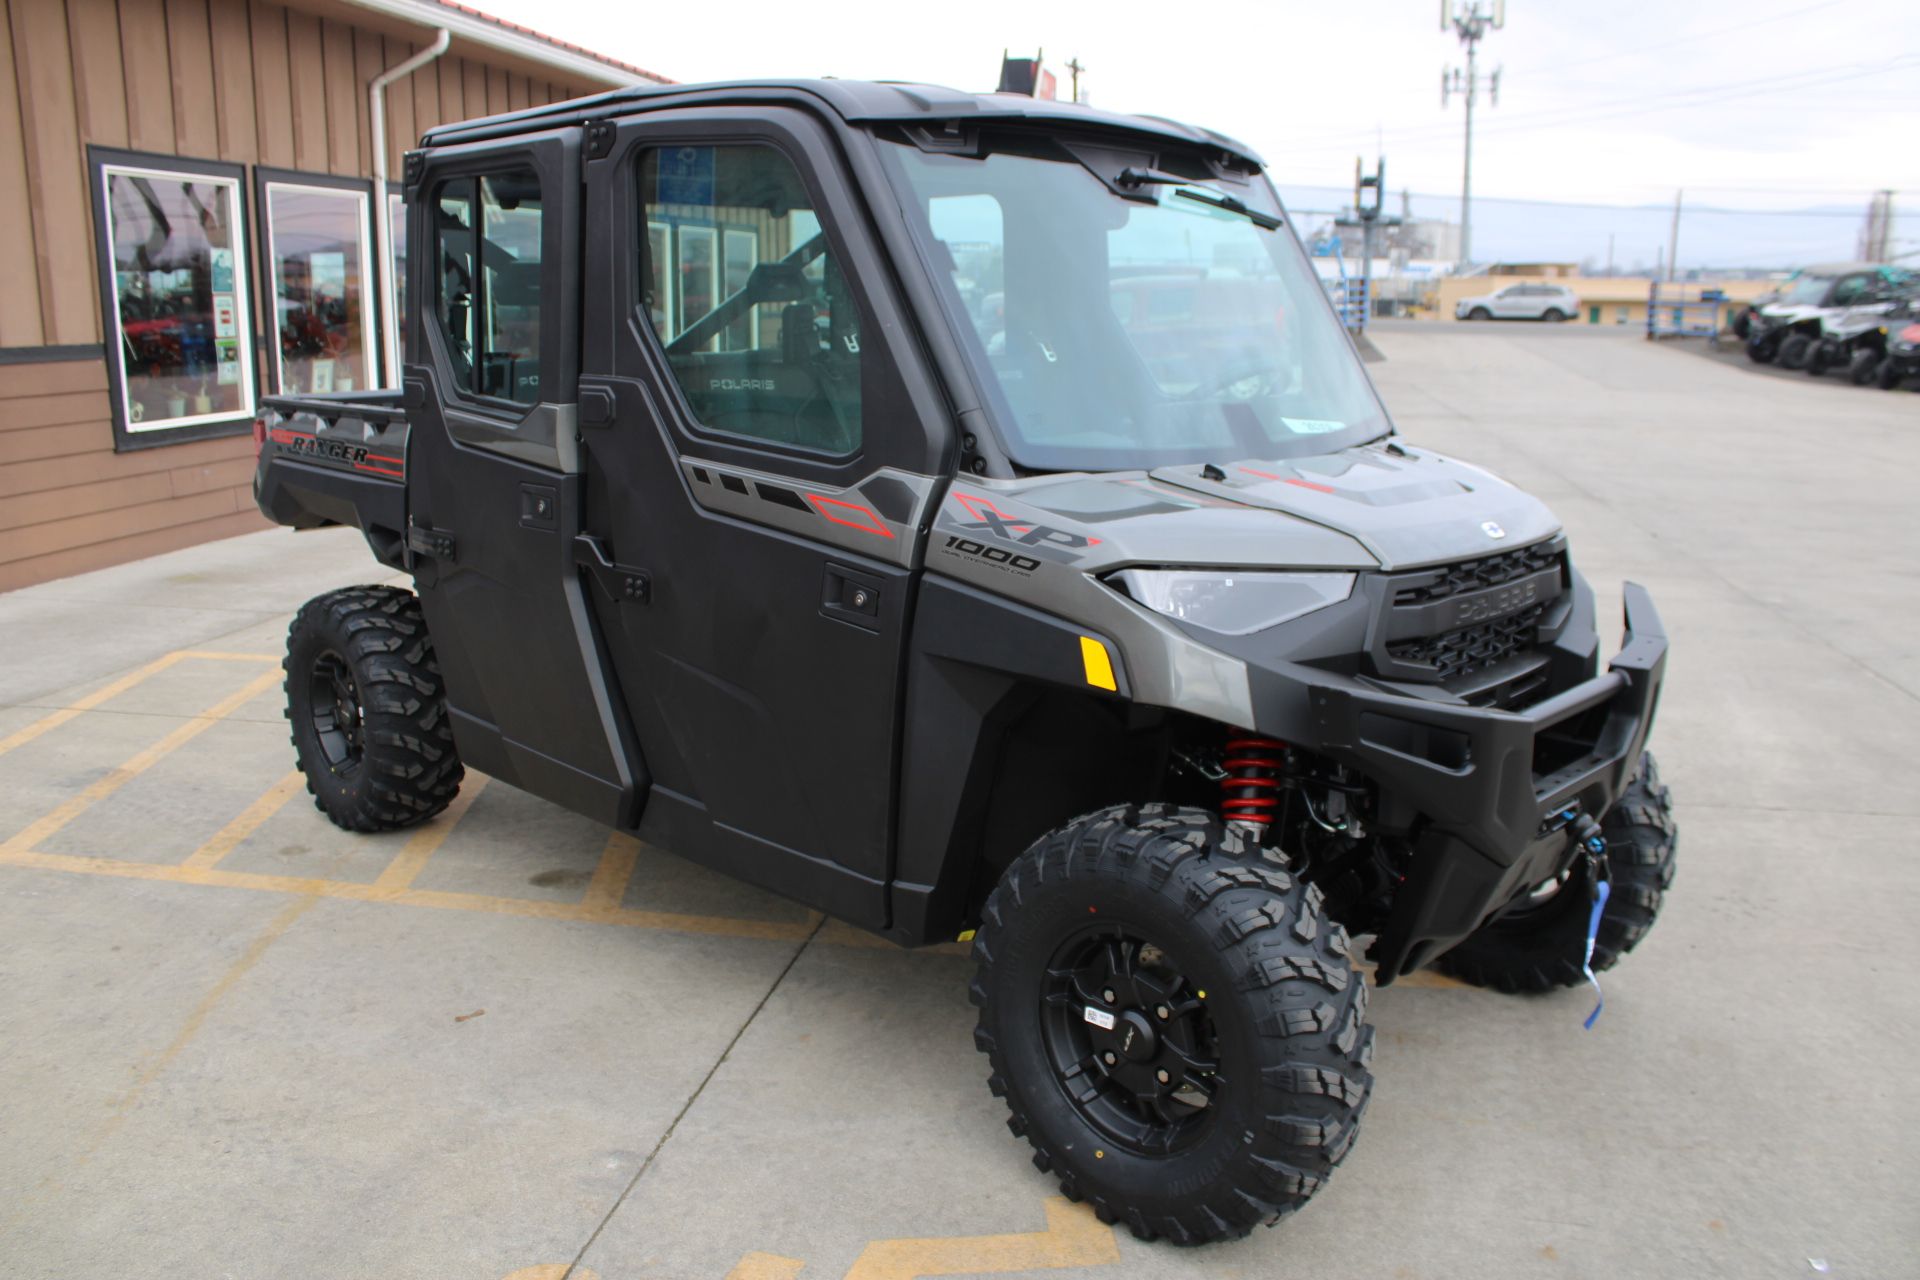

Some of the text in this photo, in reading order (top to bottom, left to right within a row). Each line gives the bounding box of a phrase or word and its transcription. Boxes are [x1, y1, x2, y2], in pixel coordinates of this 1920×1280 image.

[710, 378, 776, 391] POLARIS
[292, 437, 369, 463] RANGER
[958, 508, 1089, 548] XP
[945, 536, 1042, 571] 1000
